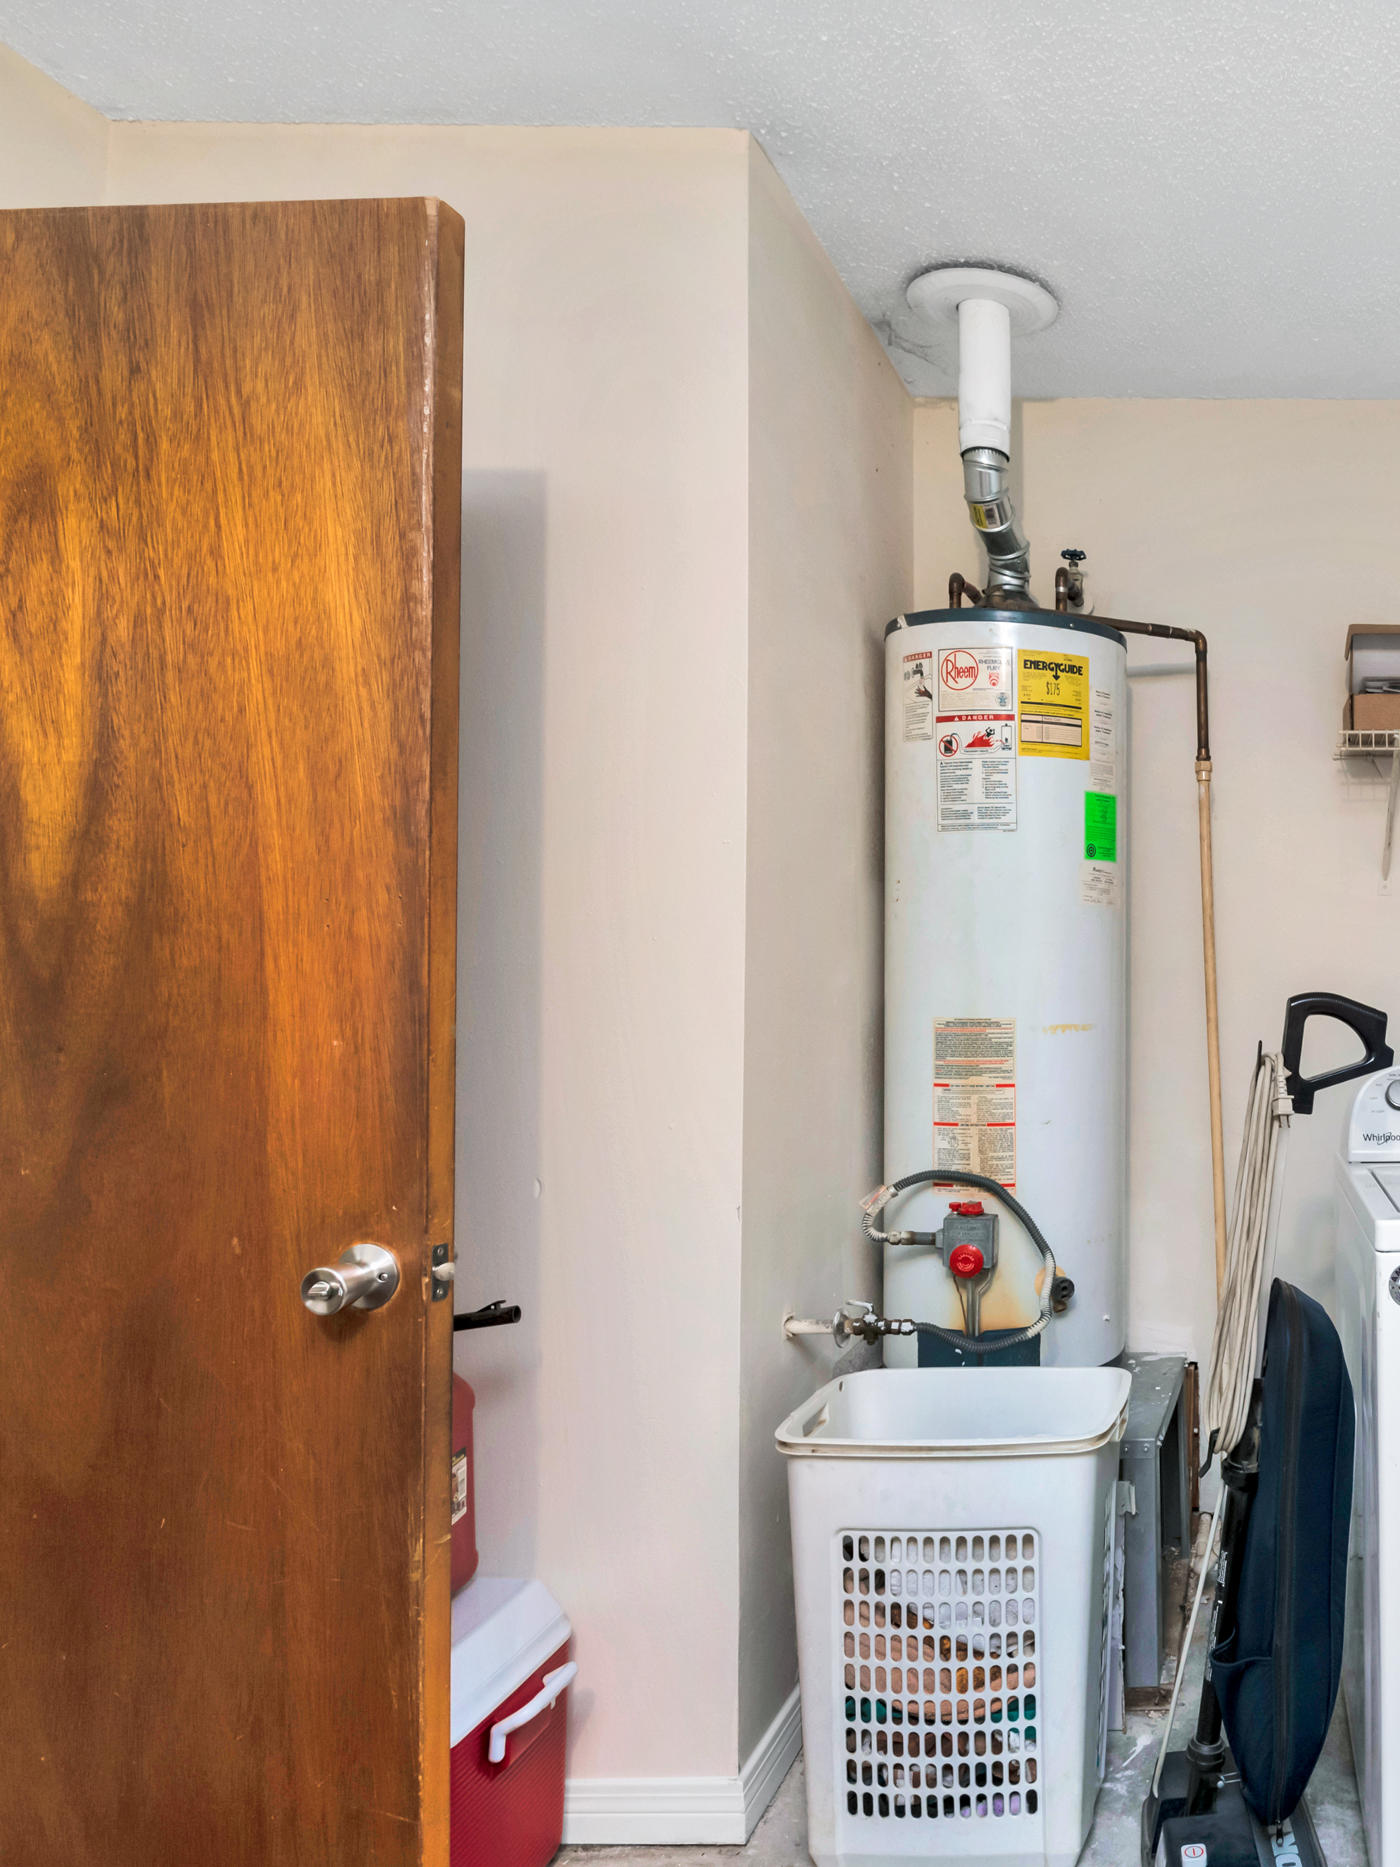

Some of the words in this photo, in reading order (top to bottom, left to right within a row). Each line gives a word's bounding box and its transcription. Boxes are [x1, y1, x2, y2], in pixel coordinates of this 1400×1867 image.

[945, 652, 976, 684] Rheem
[1023, 659, 1083, 676] ENERGYGUIDE
[1046, 681, 1060, 696] $175
